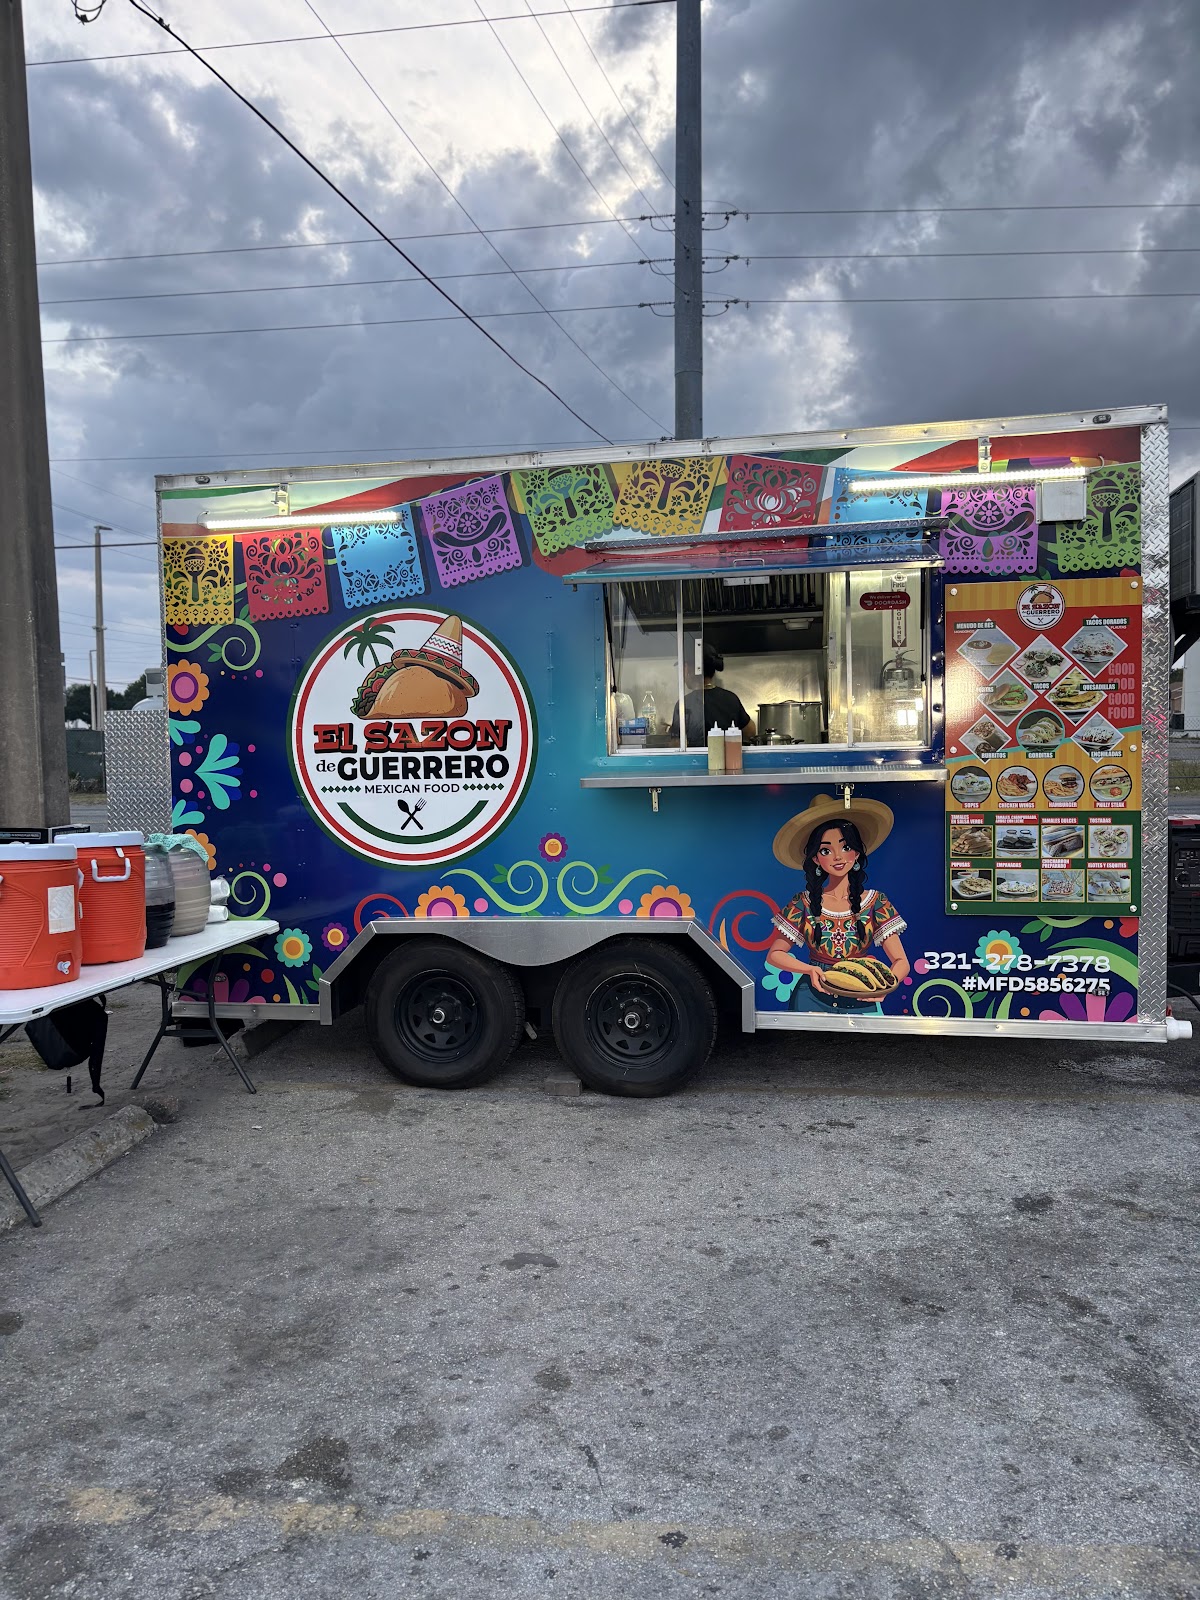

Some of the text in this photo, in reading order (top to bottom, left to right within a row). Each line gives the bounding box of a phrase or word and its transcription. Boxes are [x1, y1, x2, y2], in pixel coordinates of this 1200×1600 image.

[1108, 662, 1135, 675] GOOD
[1108, 692, 1135, 705] GOOD
[1108, 706, 1135, 719] FOOD
[363, 719, 513, 755] SAZON
[316, 754, 510, 781] de GUERRERO
[364, 783, 460, 794] MEXICAN FOOD
[924, 951, 1111, 973] 321-278-7378
[962, 976, 1111, 993] #MFD5856275
